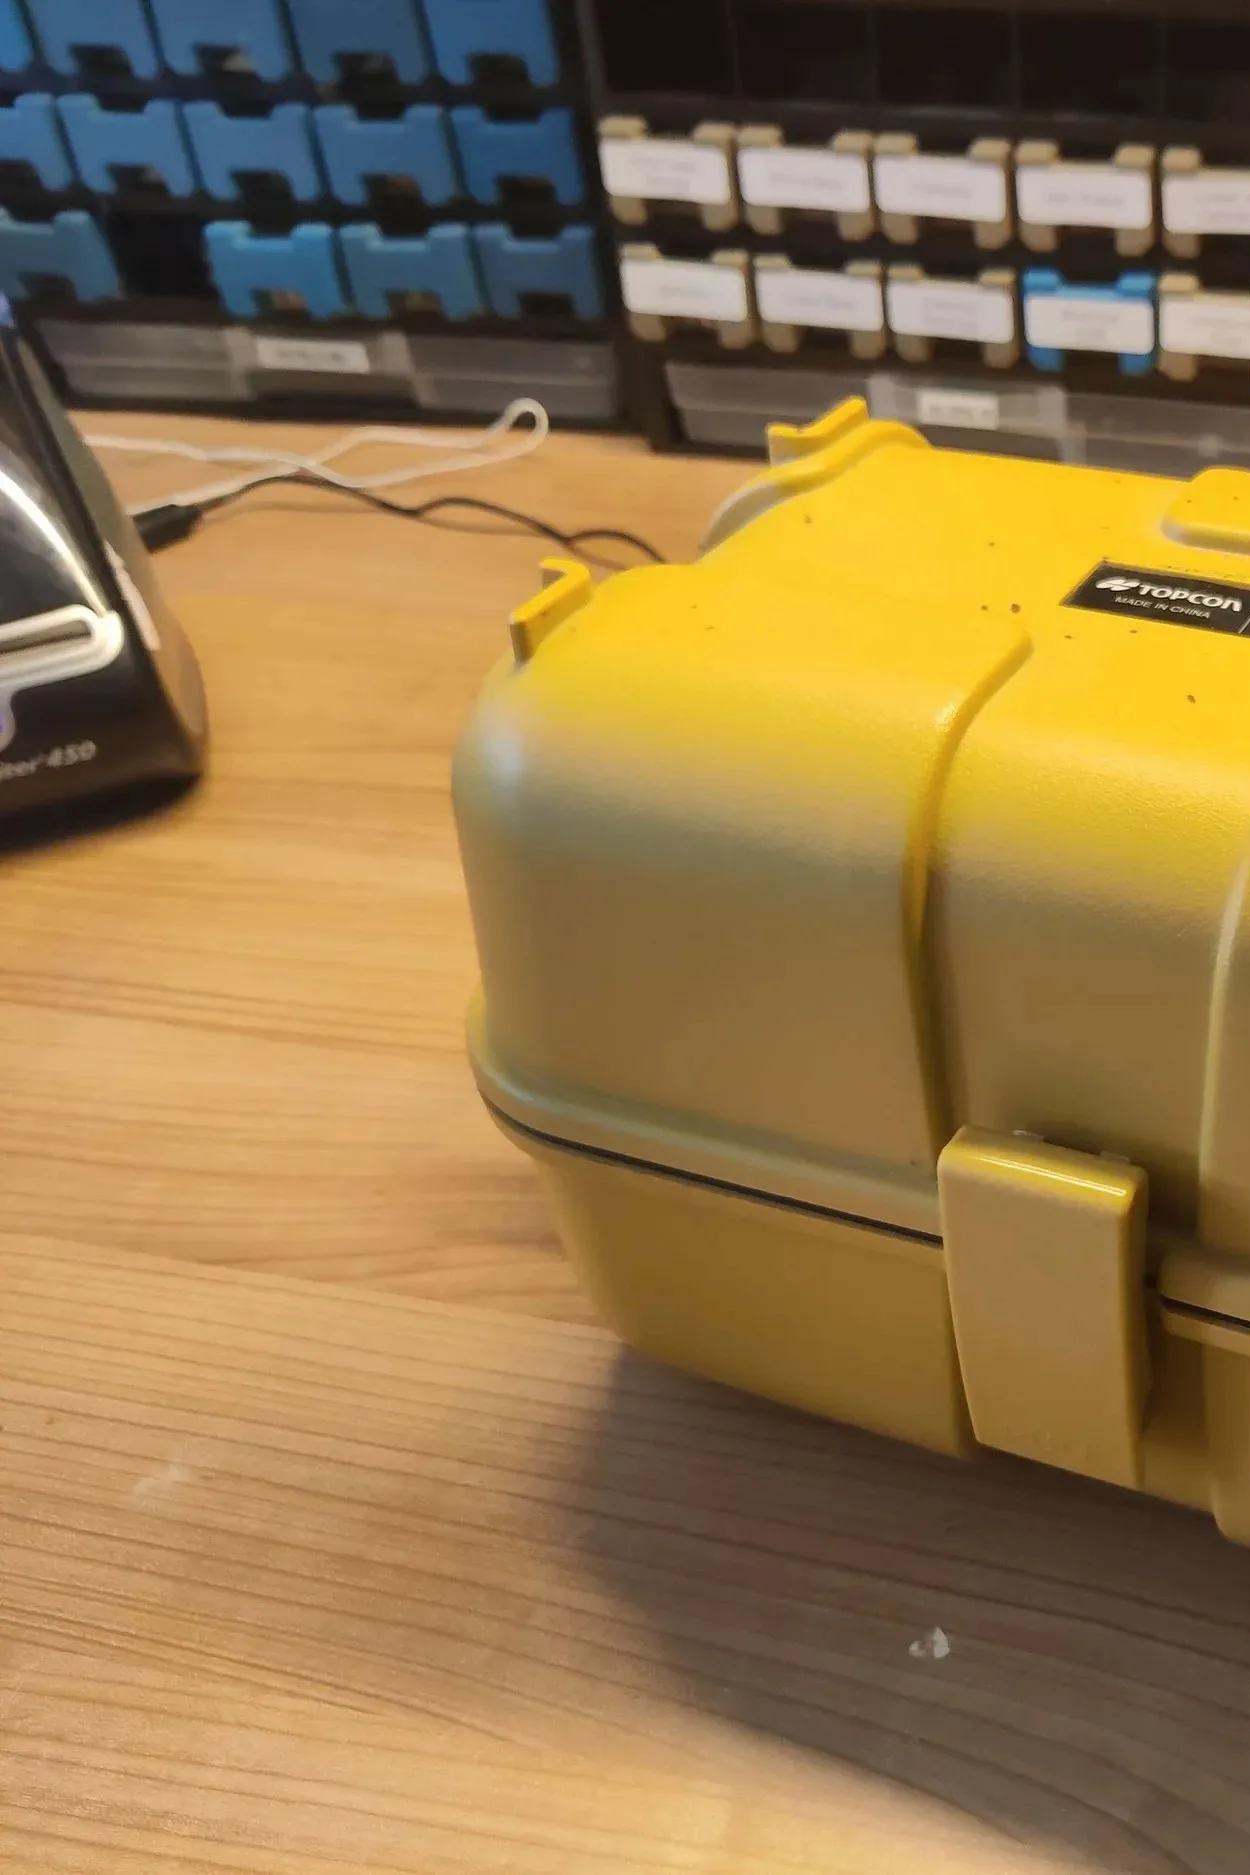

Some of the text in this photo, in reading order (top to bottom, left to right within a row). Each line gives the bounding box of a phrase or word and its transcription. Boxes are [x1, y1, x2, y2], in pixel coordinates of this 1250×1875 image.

[1115, 595, 1210, 619] MADE IN CHINA
[1140, 584, 1242, 612] TOPCON
